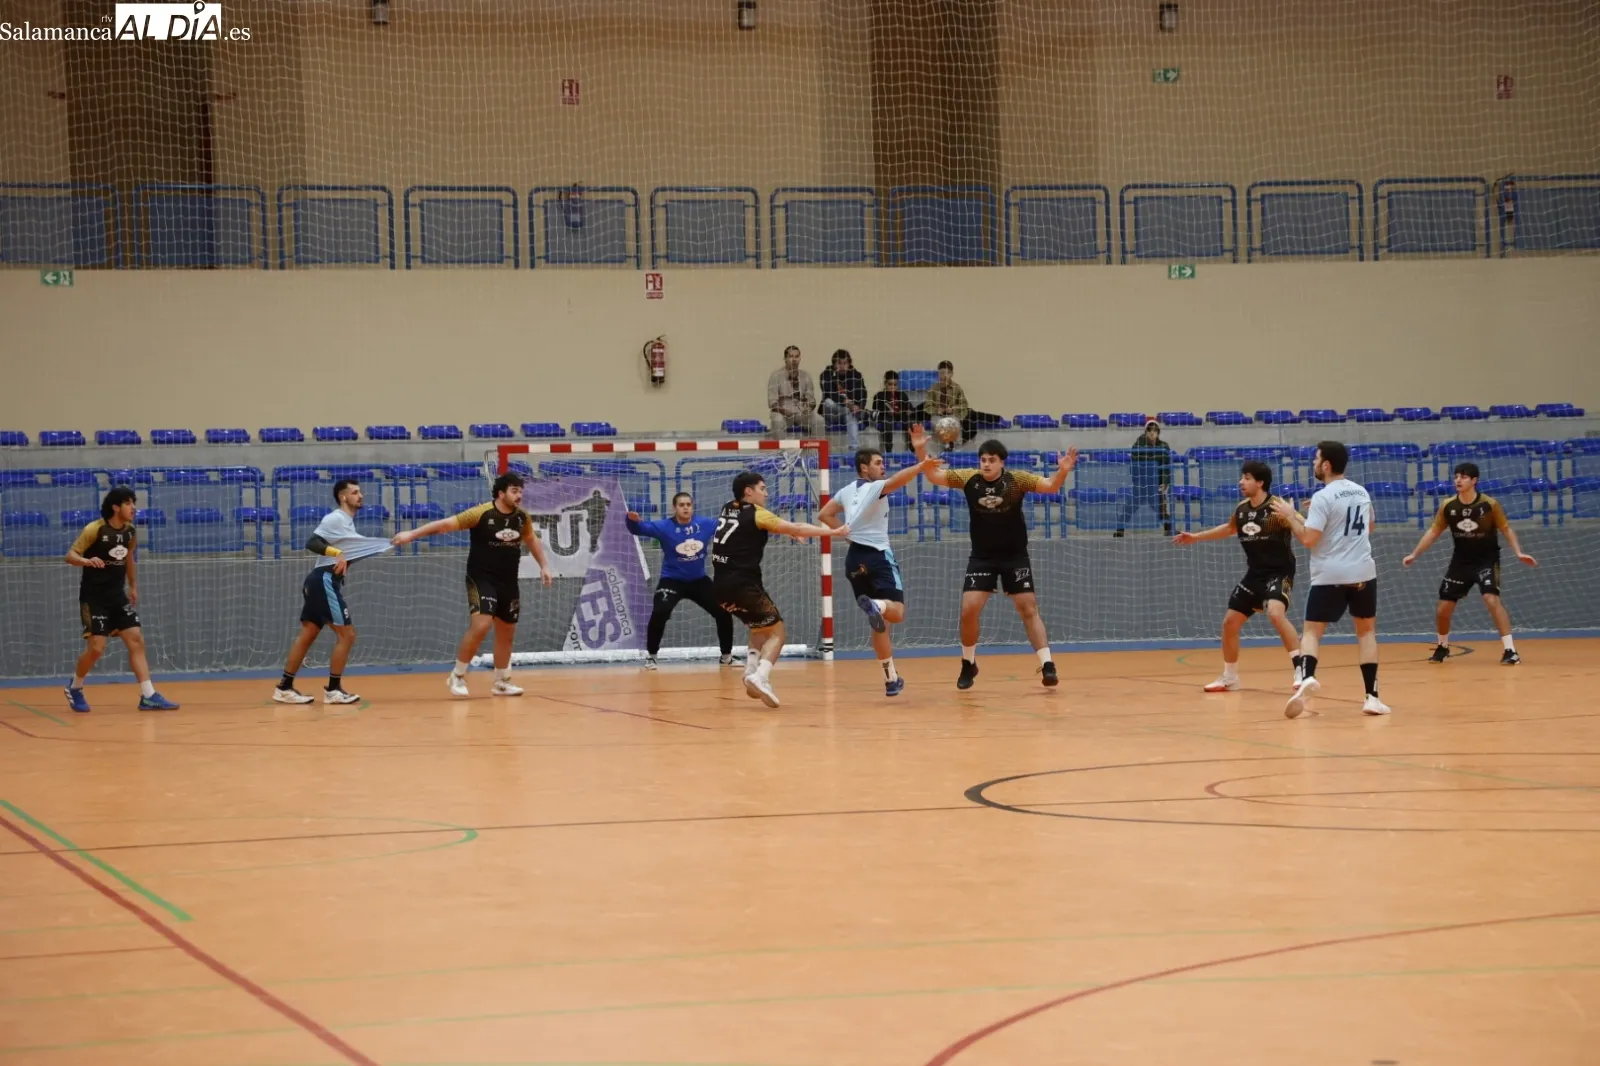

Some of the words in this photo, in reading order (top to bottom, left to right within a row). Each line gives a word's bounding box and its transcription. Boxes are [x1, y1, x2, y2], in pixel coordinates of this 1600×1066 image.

[1344, 505, 1365, 536] 14
[1462, 508, 1472, 516] 67
[502, 530, 515, 538] CG
[713, 517, 740, 544] 27
[683, 543, 698, 552] CG
[607, 567, 632, 636] salamanca
